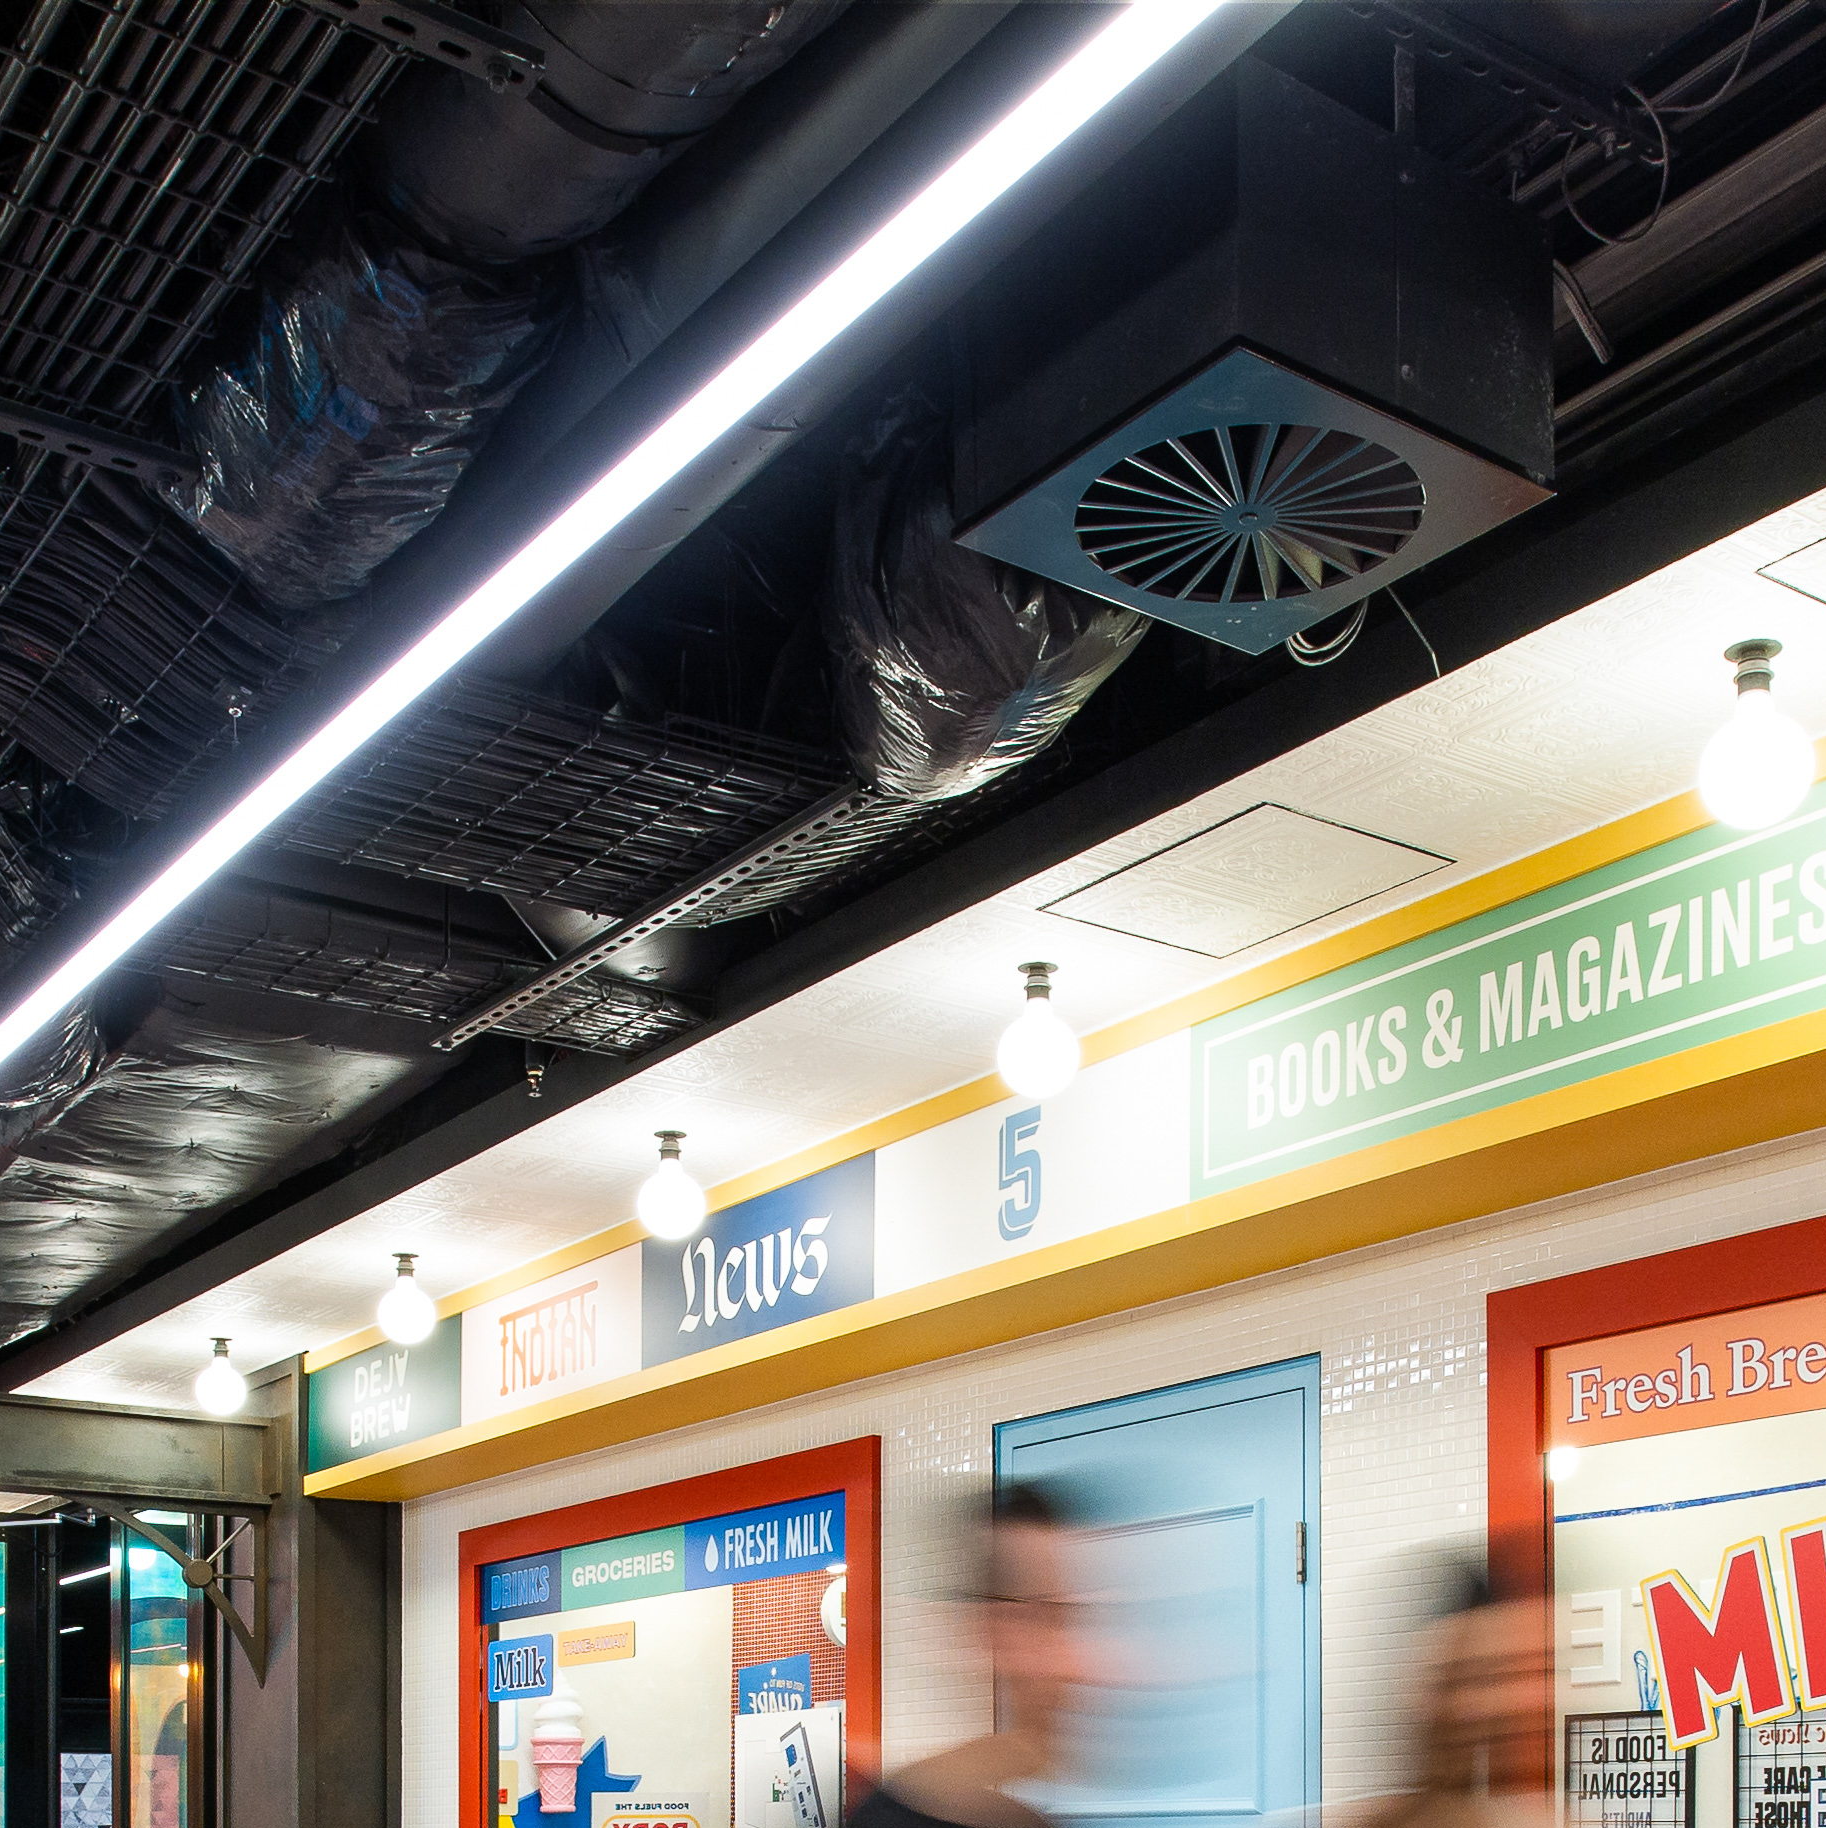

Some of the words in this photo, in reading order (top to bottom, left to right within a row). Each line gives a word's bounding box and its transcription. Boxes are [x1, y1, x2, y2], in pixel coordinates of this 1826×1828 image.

[1246, 1004, 1408, 1131] BOOKS
[1421, 987, 1465, 1070] &
[998, 1105, 1041, 1241] 5
[677, 1212, 834, 1336] News
[498, 1280, 599, 1397] INDIAN
[1567, 1345, 1715, 1426] Fresh
[572, 1549, 675, 1588] GROCERIES
[724, 1520, 778, 1571] FRESH
[785, 1509, 834, 1560] MILK
[491, 1565, 550, 1611] DRINKS
[493, 1646, 546, 1691] Milk
[562, 1633, 629, 1657] TAKE-AWAY
